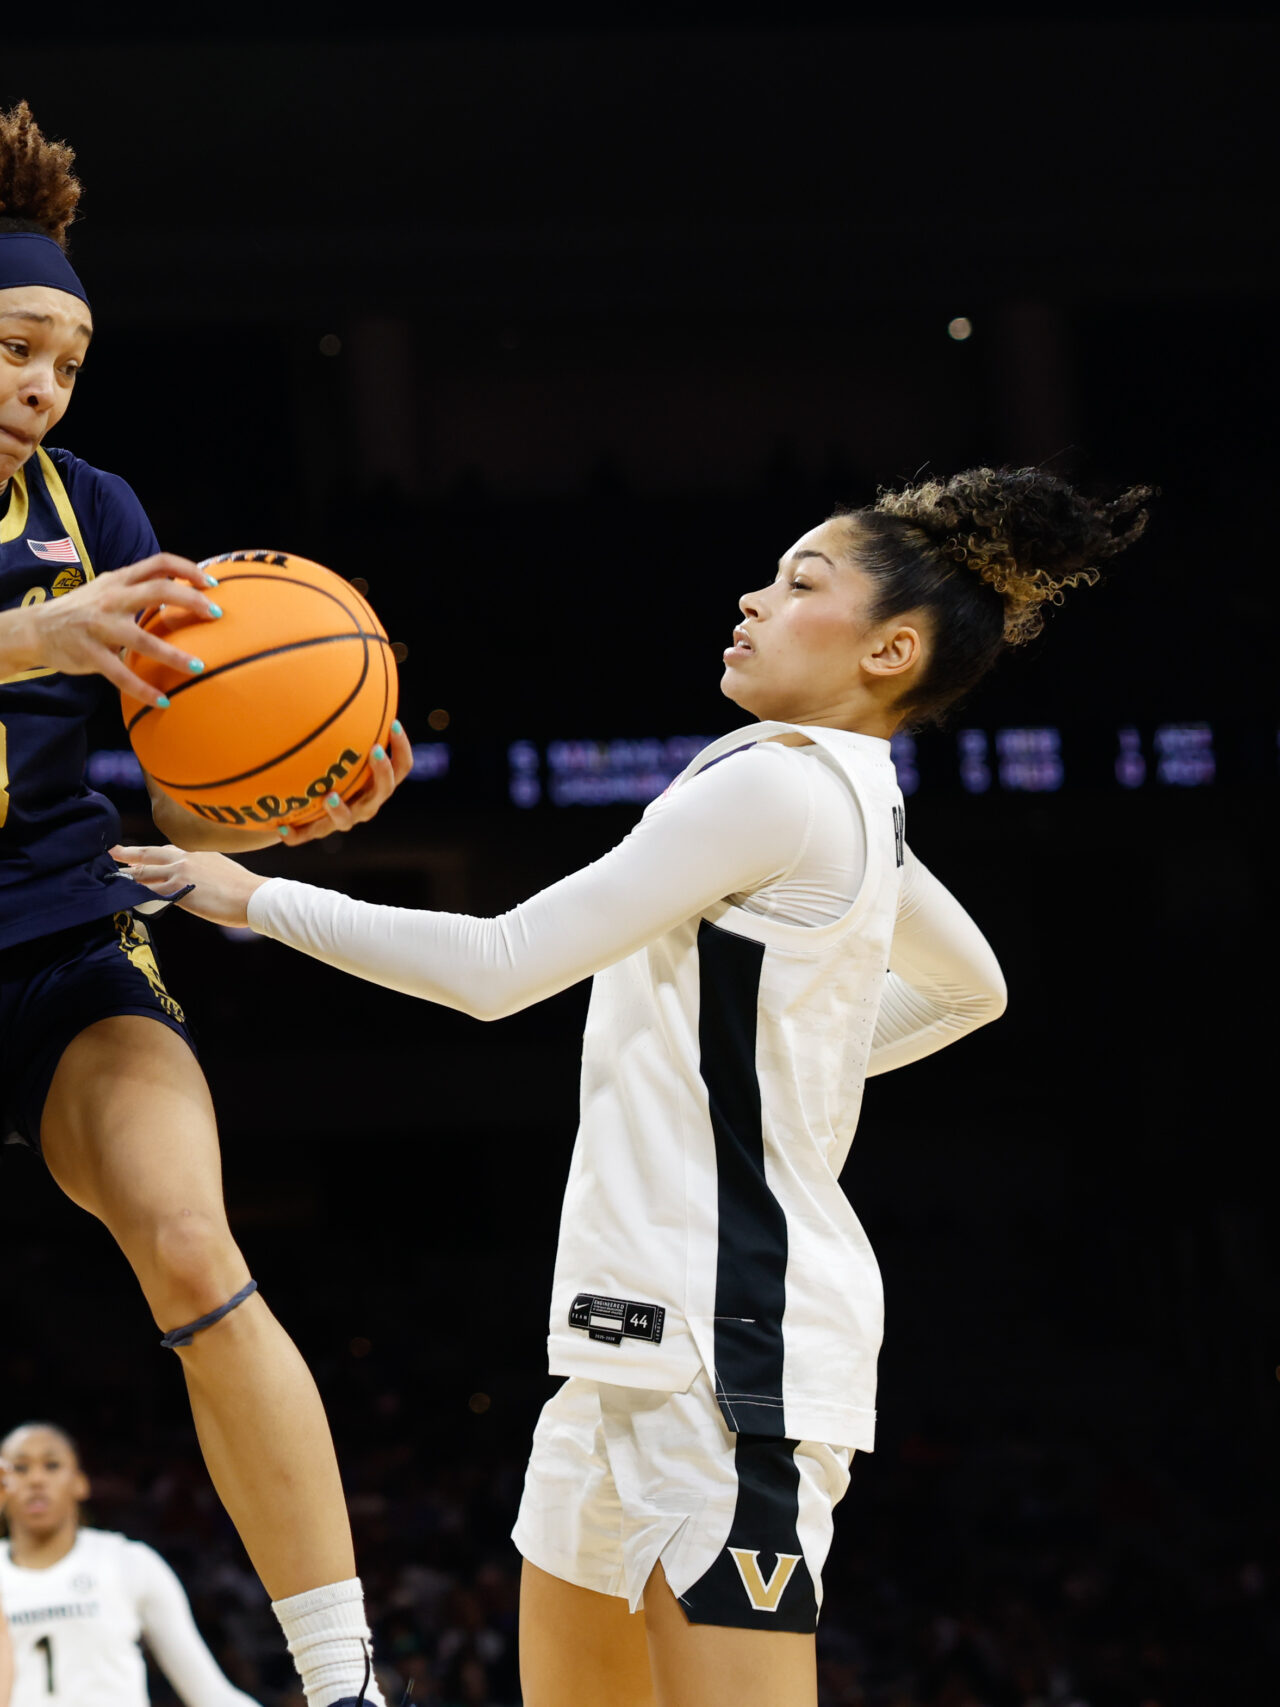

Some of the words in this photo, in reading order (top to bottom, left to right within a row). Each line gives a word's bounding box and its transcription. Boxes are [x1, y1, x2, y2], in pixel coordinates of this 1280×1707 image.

[185, 747, 362, 826] Wilson
[629, 1313, 648, 1329] 44
[727, 1547, 803, 1613] V
[33, 1634, 54, 1694] 1
